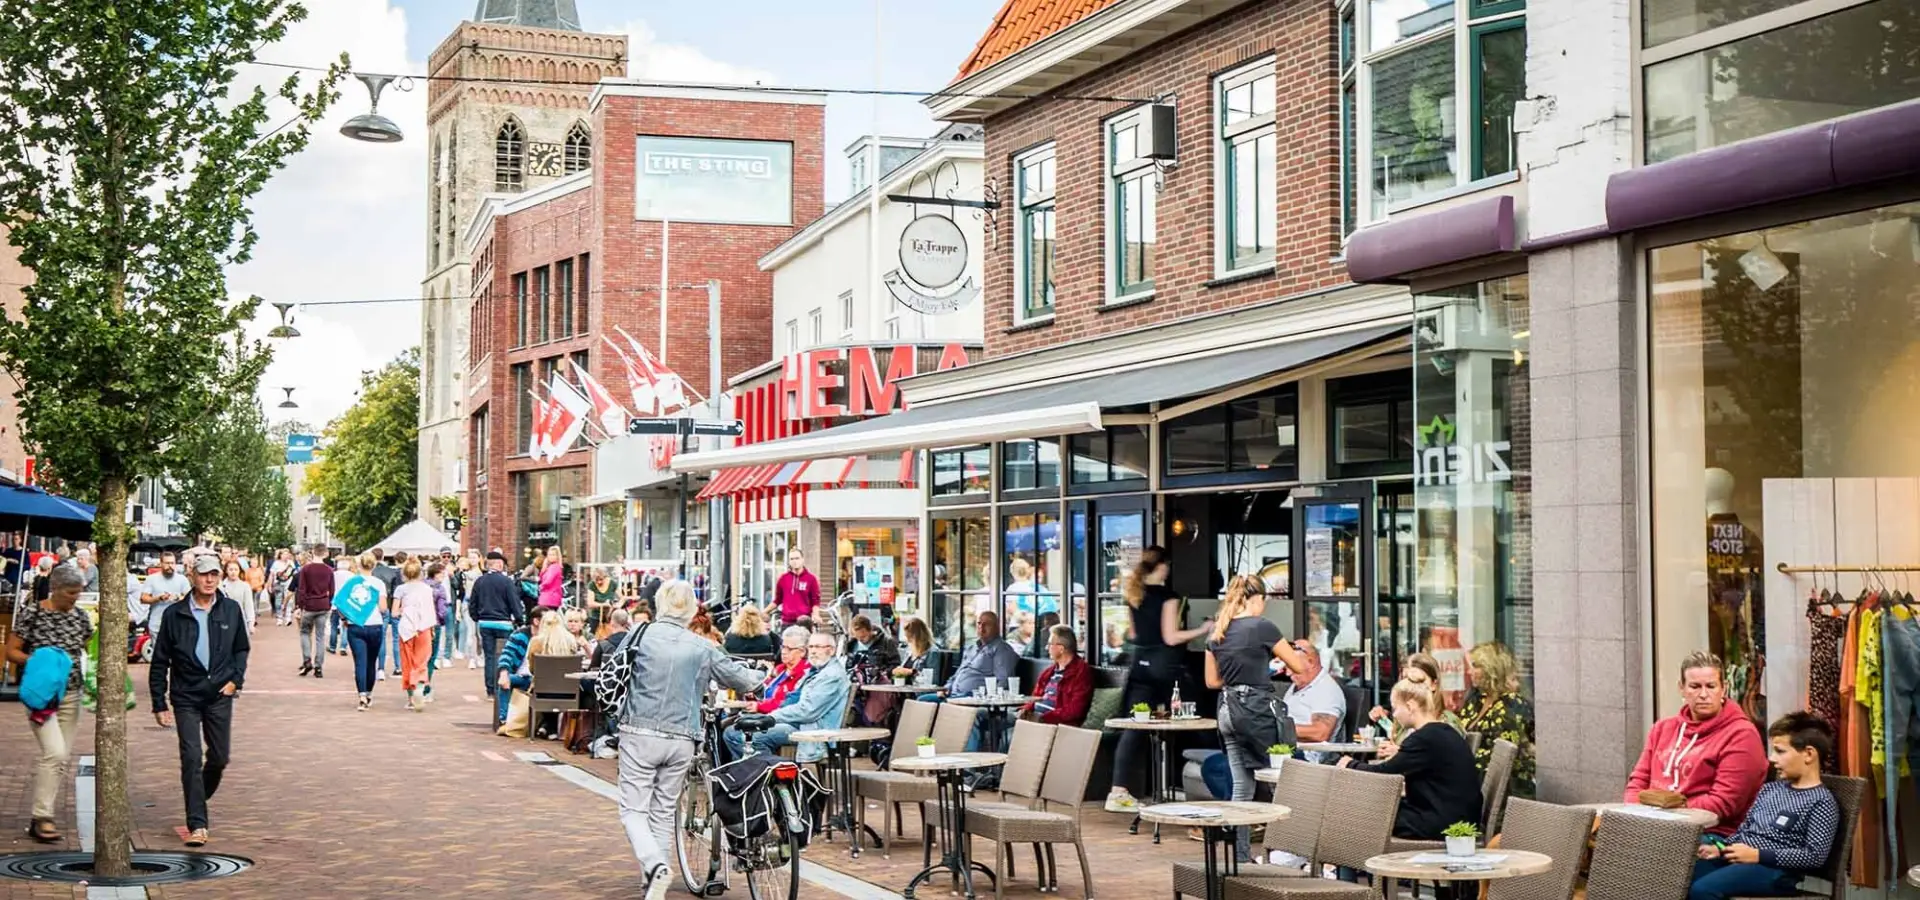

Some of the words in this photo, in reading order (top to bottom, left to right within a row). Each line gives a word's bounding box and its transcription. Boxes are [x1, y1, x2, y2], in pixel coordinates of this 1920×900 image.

[651, 156, 692, 170] THE
[699, 158, 766, 174] STING
[910, 238, 923, 253] La
[924, 240, 959, 256] Trappe
